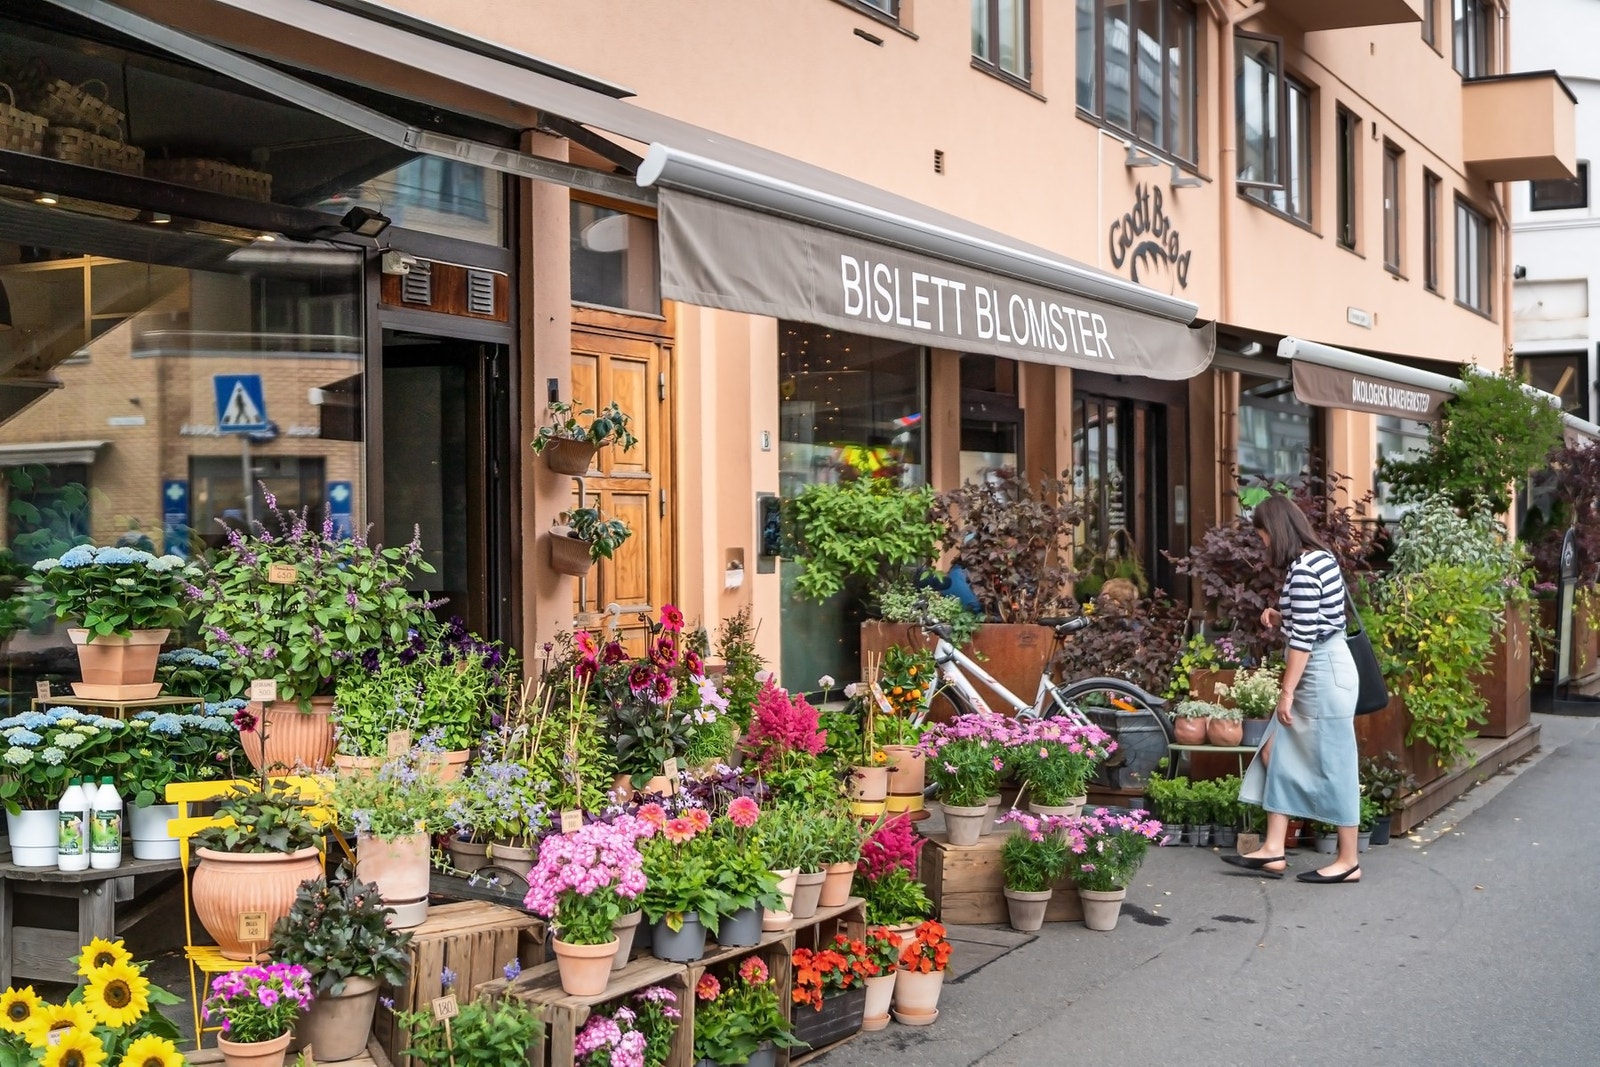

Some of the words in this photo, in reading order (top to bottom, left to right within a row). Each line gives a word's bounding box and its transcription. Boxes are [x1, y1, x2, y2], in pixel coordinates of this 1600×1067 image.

[1109, 181, 1150, 269] Godt
[1151, 184, 1191, 290] Brød
[840, 254, 967, 336] BISLETT
[974, 285, 1115, 360] BLOMSTER
[1352, 376, 1389, 407] ØKOLOGISK
